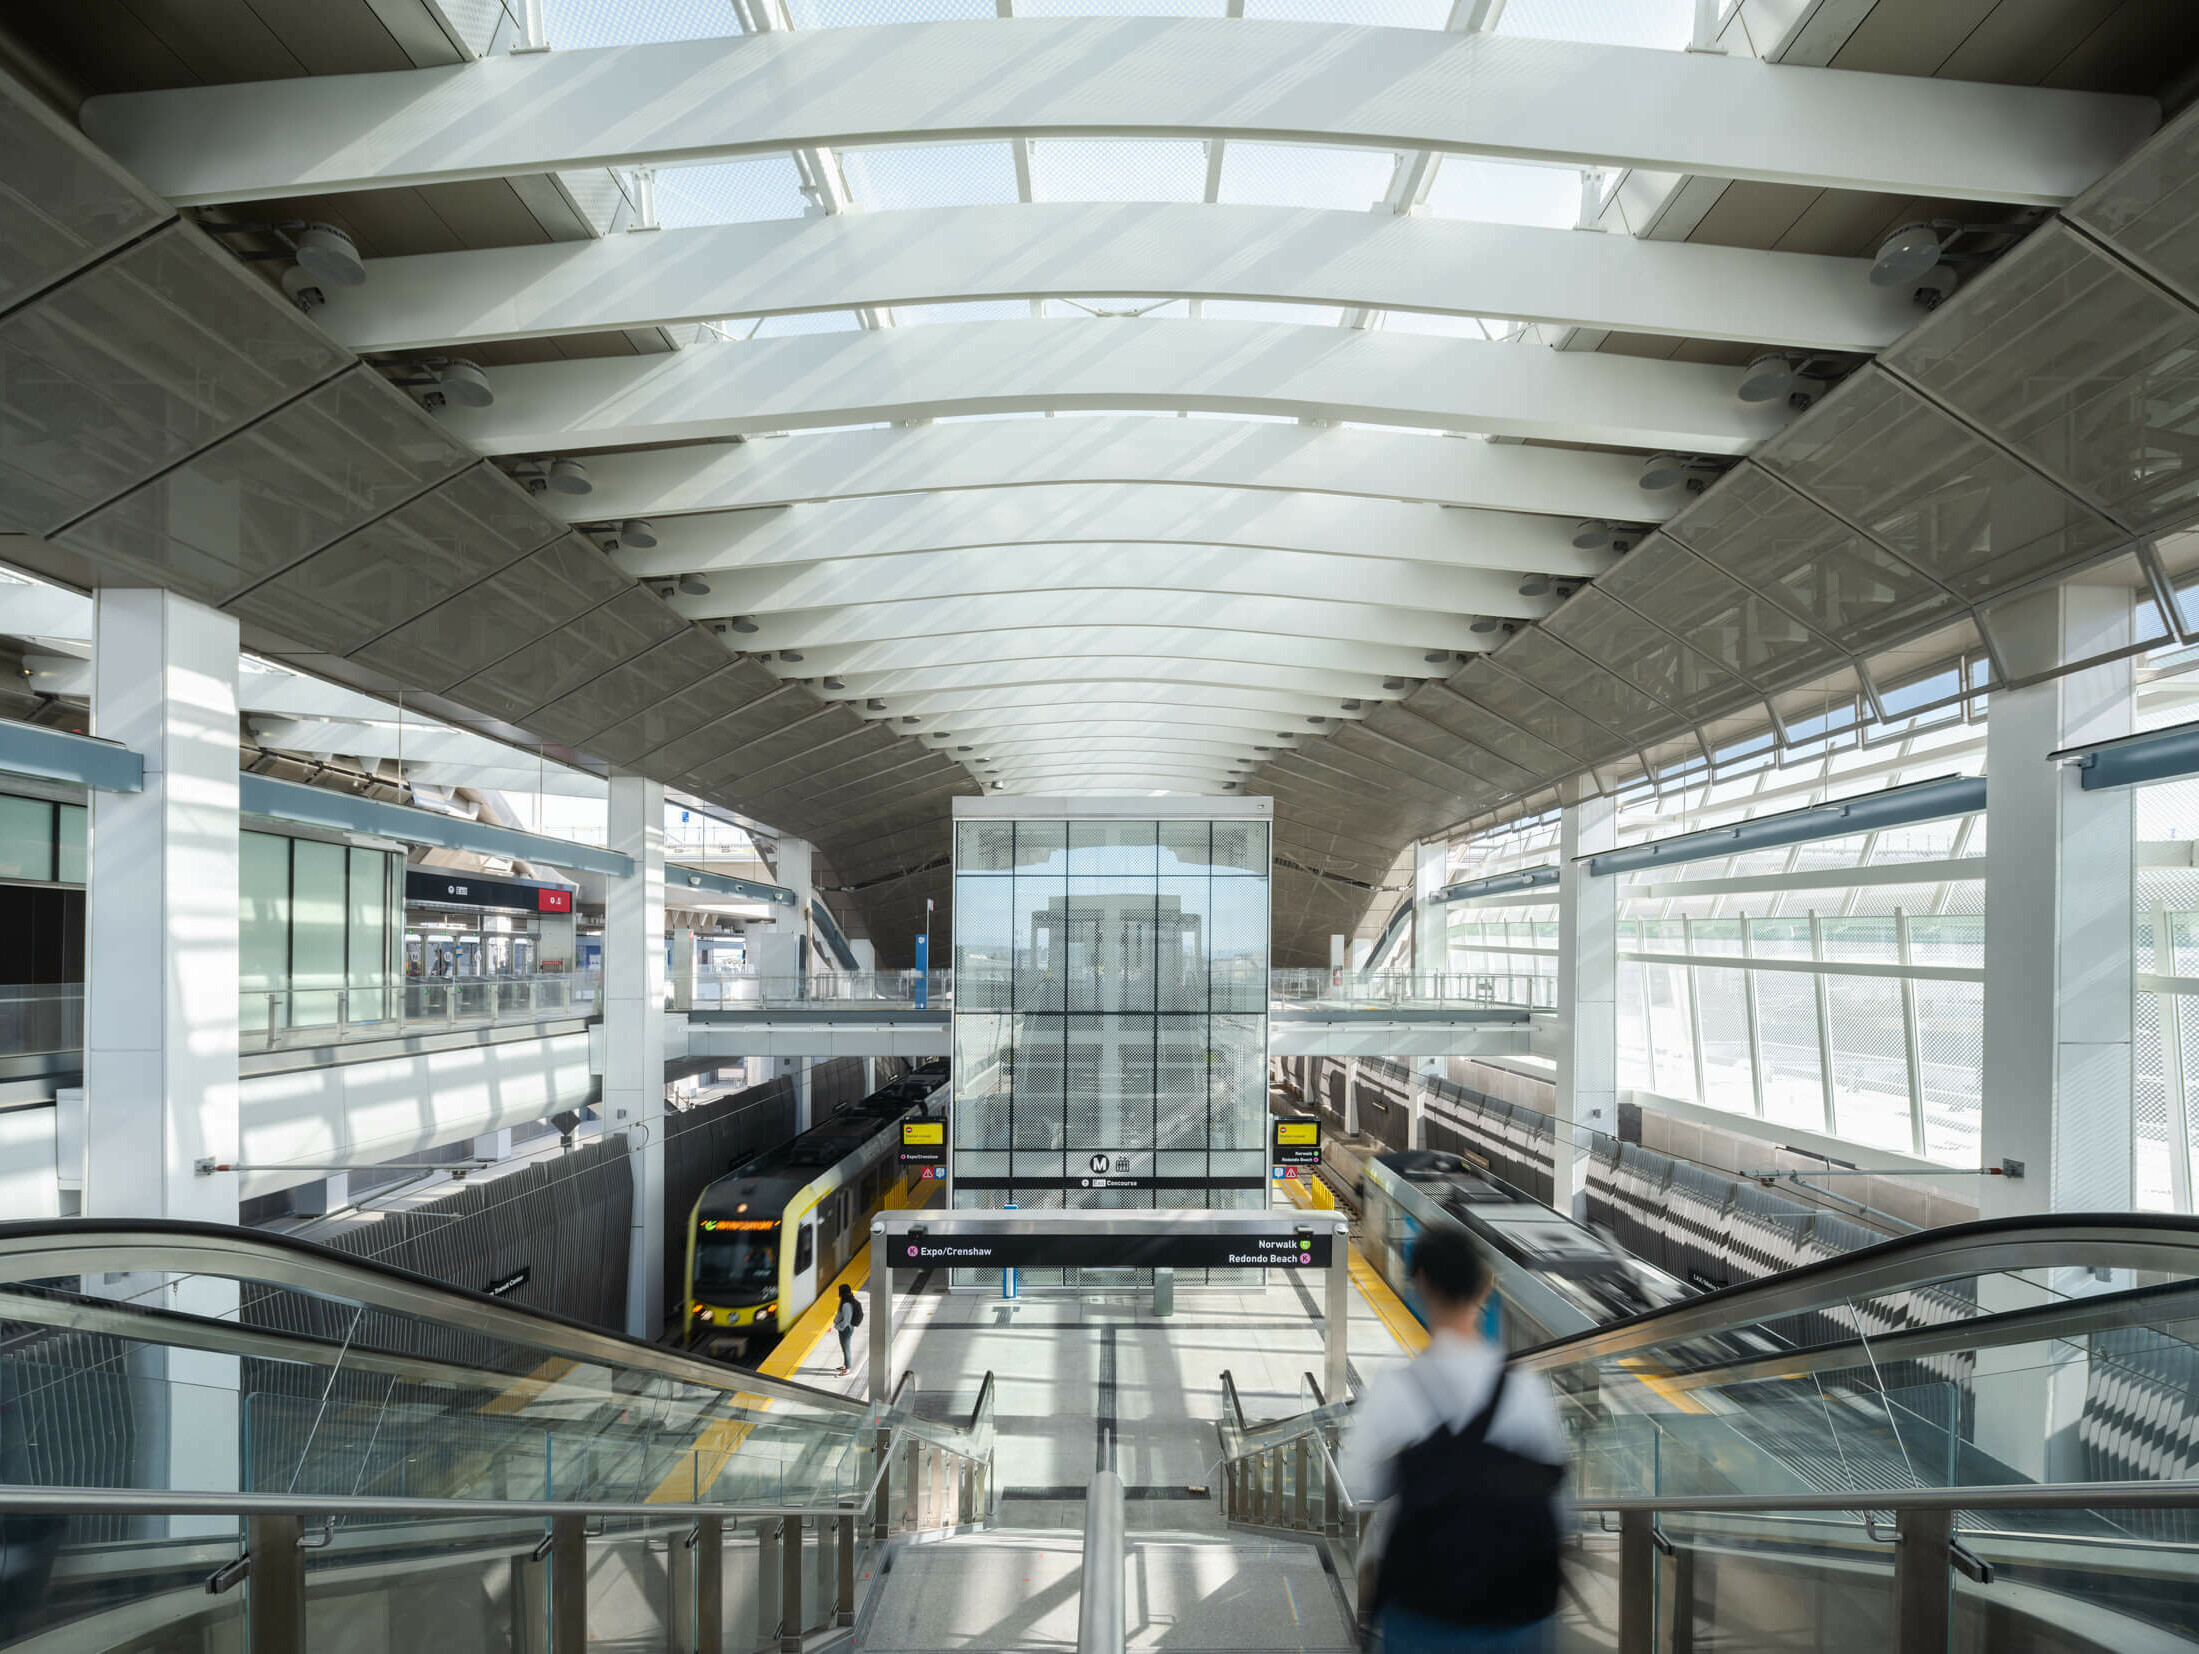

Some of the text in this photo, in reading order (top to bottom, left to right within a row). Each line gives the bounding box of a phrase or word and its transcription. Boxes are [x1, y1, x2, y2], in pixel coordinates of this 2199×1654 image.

[1093, 1157, 1107, 1171] M
[1258, 1240, 1298, 1249] Norwalk
[920, 1247, 992, 1257] Expo/Crenshaw
[1228, 1254, 1268, 1263] Redondo
[1270, 1254, 1298, 1263] Beach
